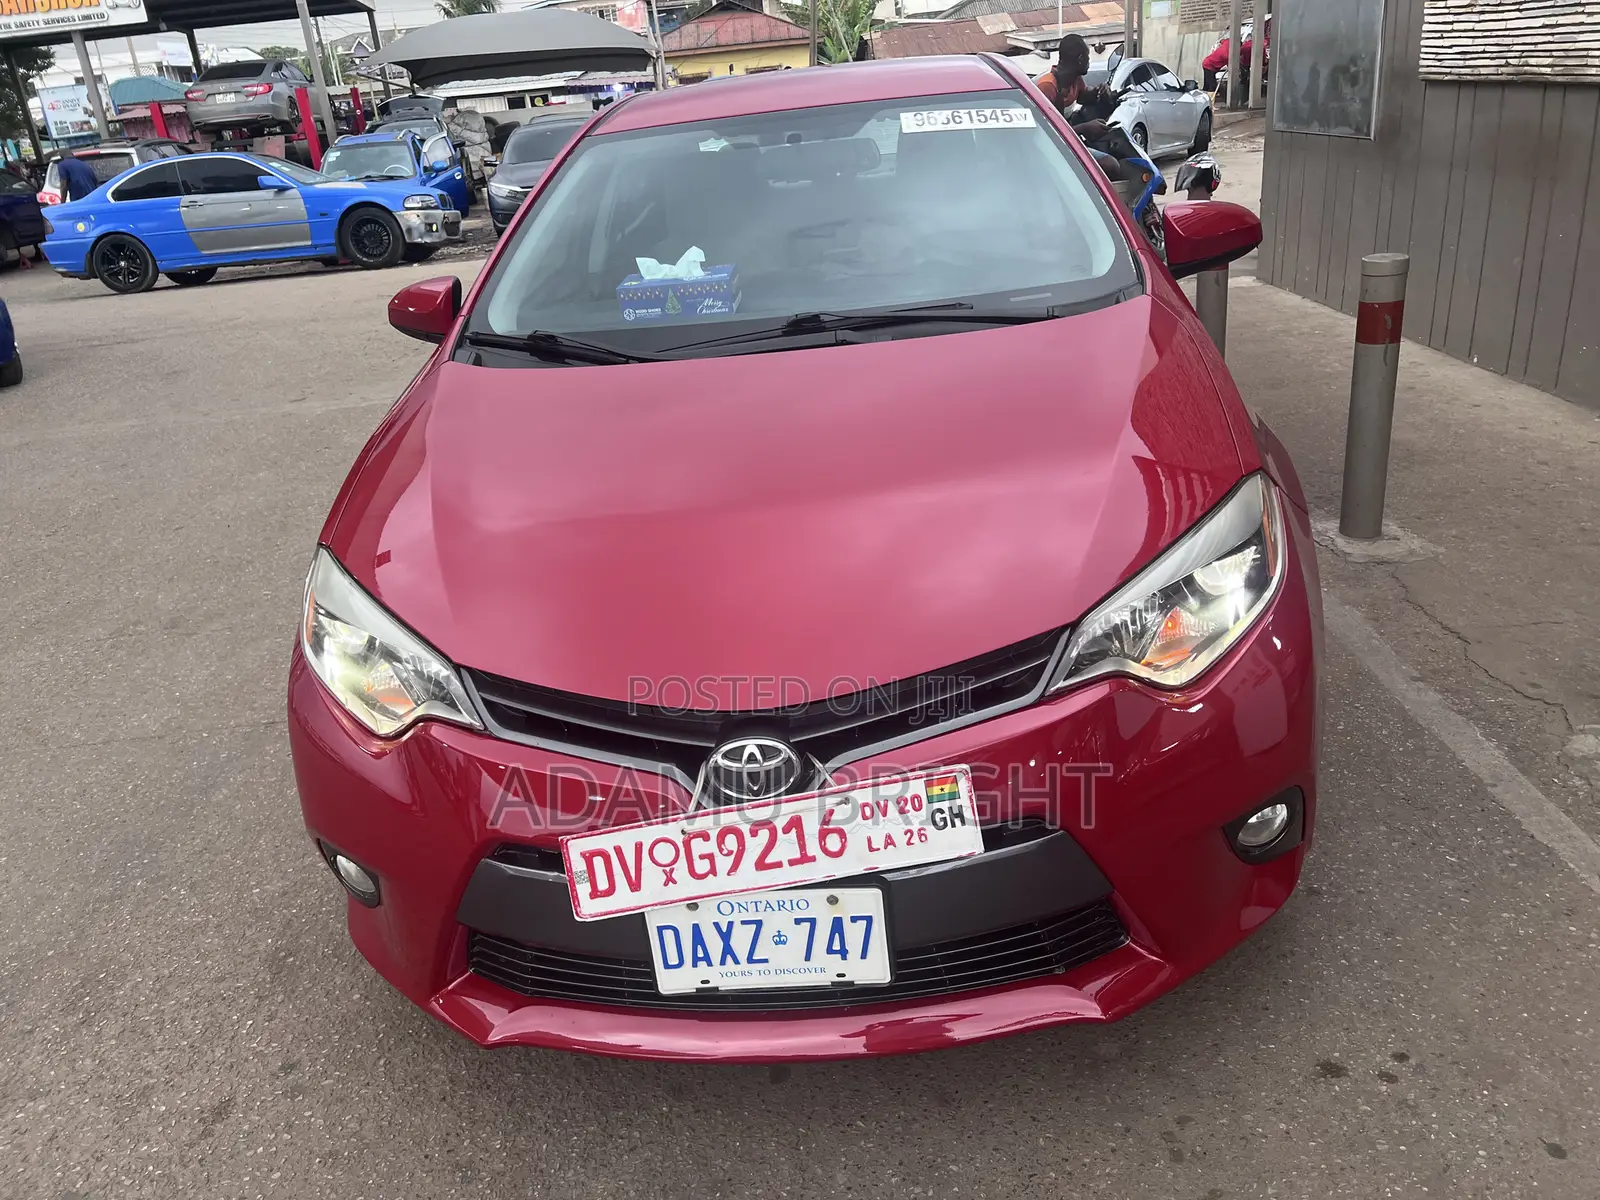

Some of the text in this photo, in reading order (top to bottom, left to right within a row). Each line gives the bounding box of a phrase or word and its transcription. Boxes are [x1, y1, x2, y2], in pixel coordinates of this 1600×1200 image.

[14, 19, 40, 29] SAFETY
[43, 15, 76, 26] SERVICES
[77, 11, 106, 22] LIMITED
[697, 304, 729, 315] Christmas
[702, 297, 723, 308] Merry
[860, 793, 923, 821] DV 20
[930, 804, 967, 831] GH
[866, 827, 928, 853] LA 26
[580, 841, 643, 900] DV
[682, 808, 848, 881] G9216
[716, 898, 810, 917] ONTARIO
[656, 915, 873, 970] DAXZ 747
[718, 966, 827, 979] YOURS TO DISCOVER
